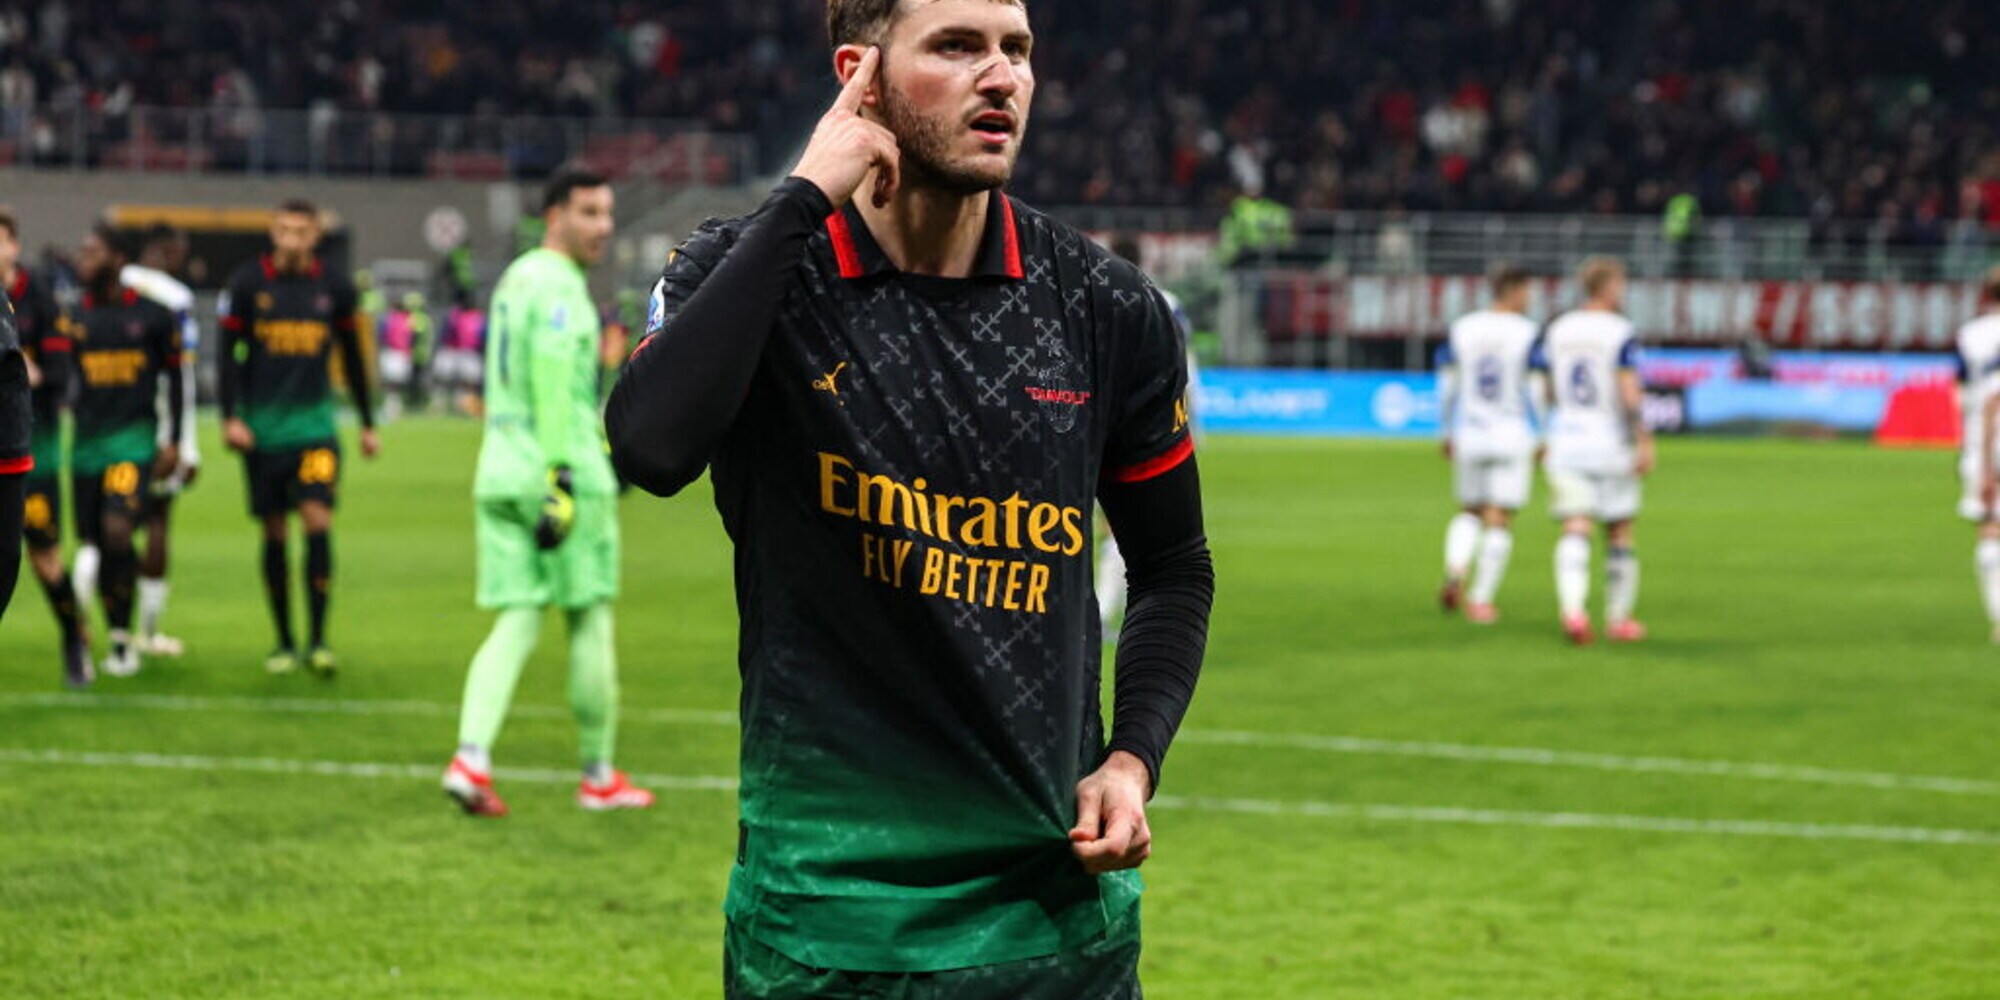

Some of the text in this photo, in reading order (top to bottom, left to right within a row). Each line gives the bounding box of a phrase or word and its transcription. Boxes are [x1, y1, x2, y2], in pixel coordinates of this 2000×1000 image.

[818, 451, 1084, 557] Emirates
[862, 533, 1051, 614] FLY BETTER
